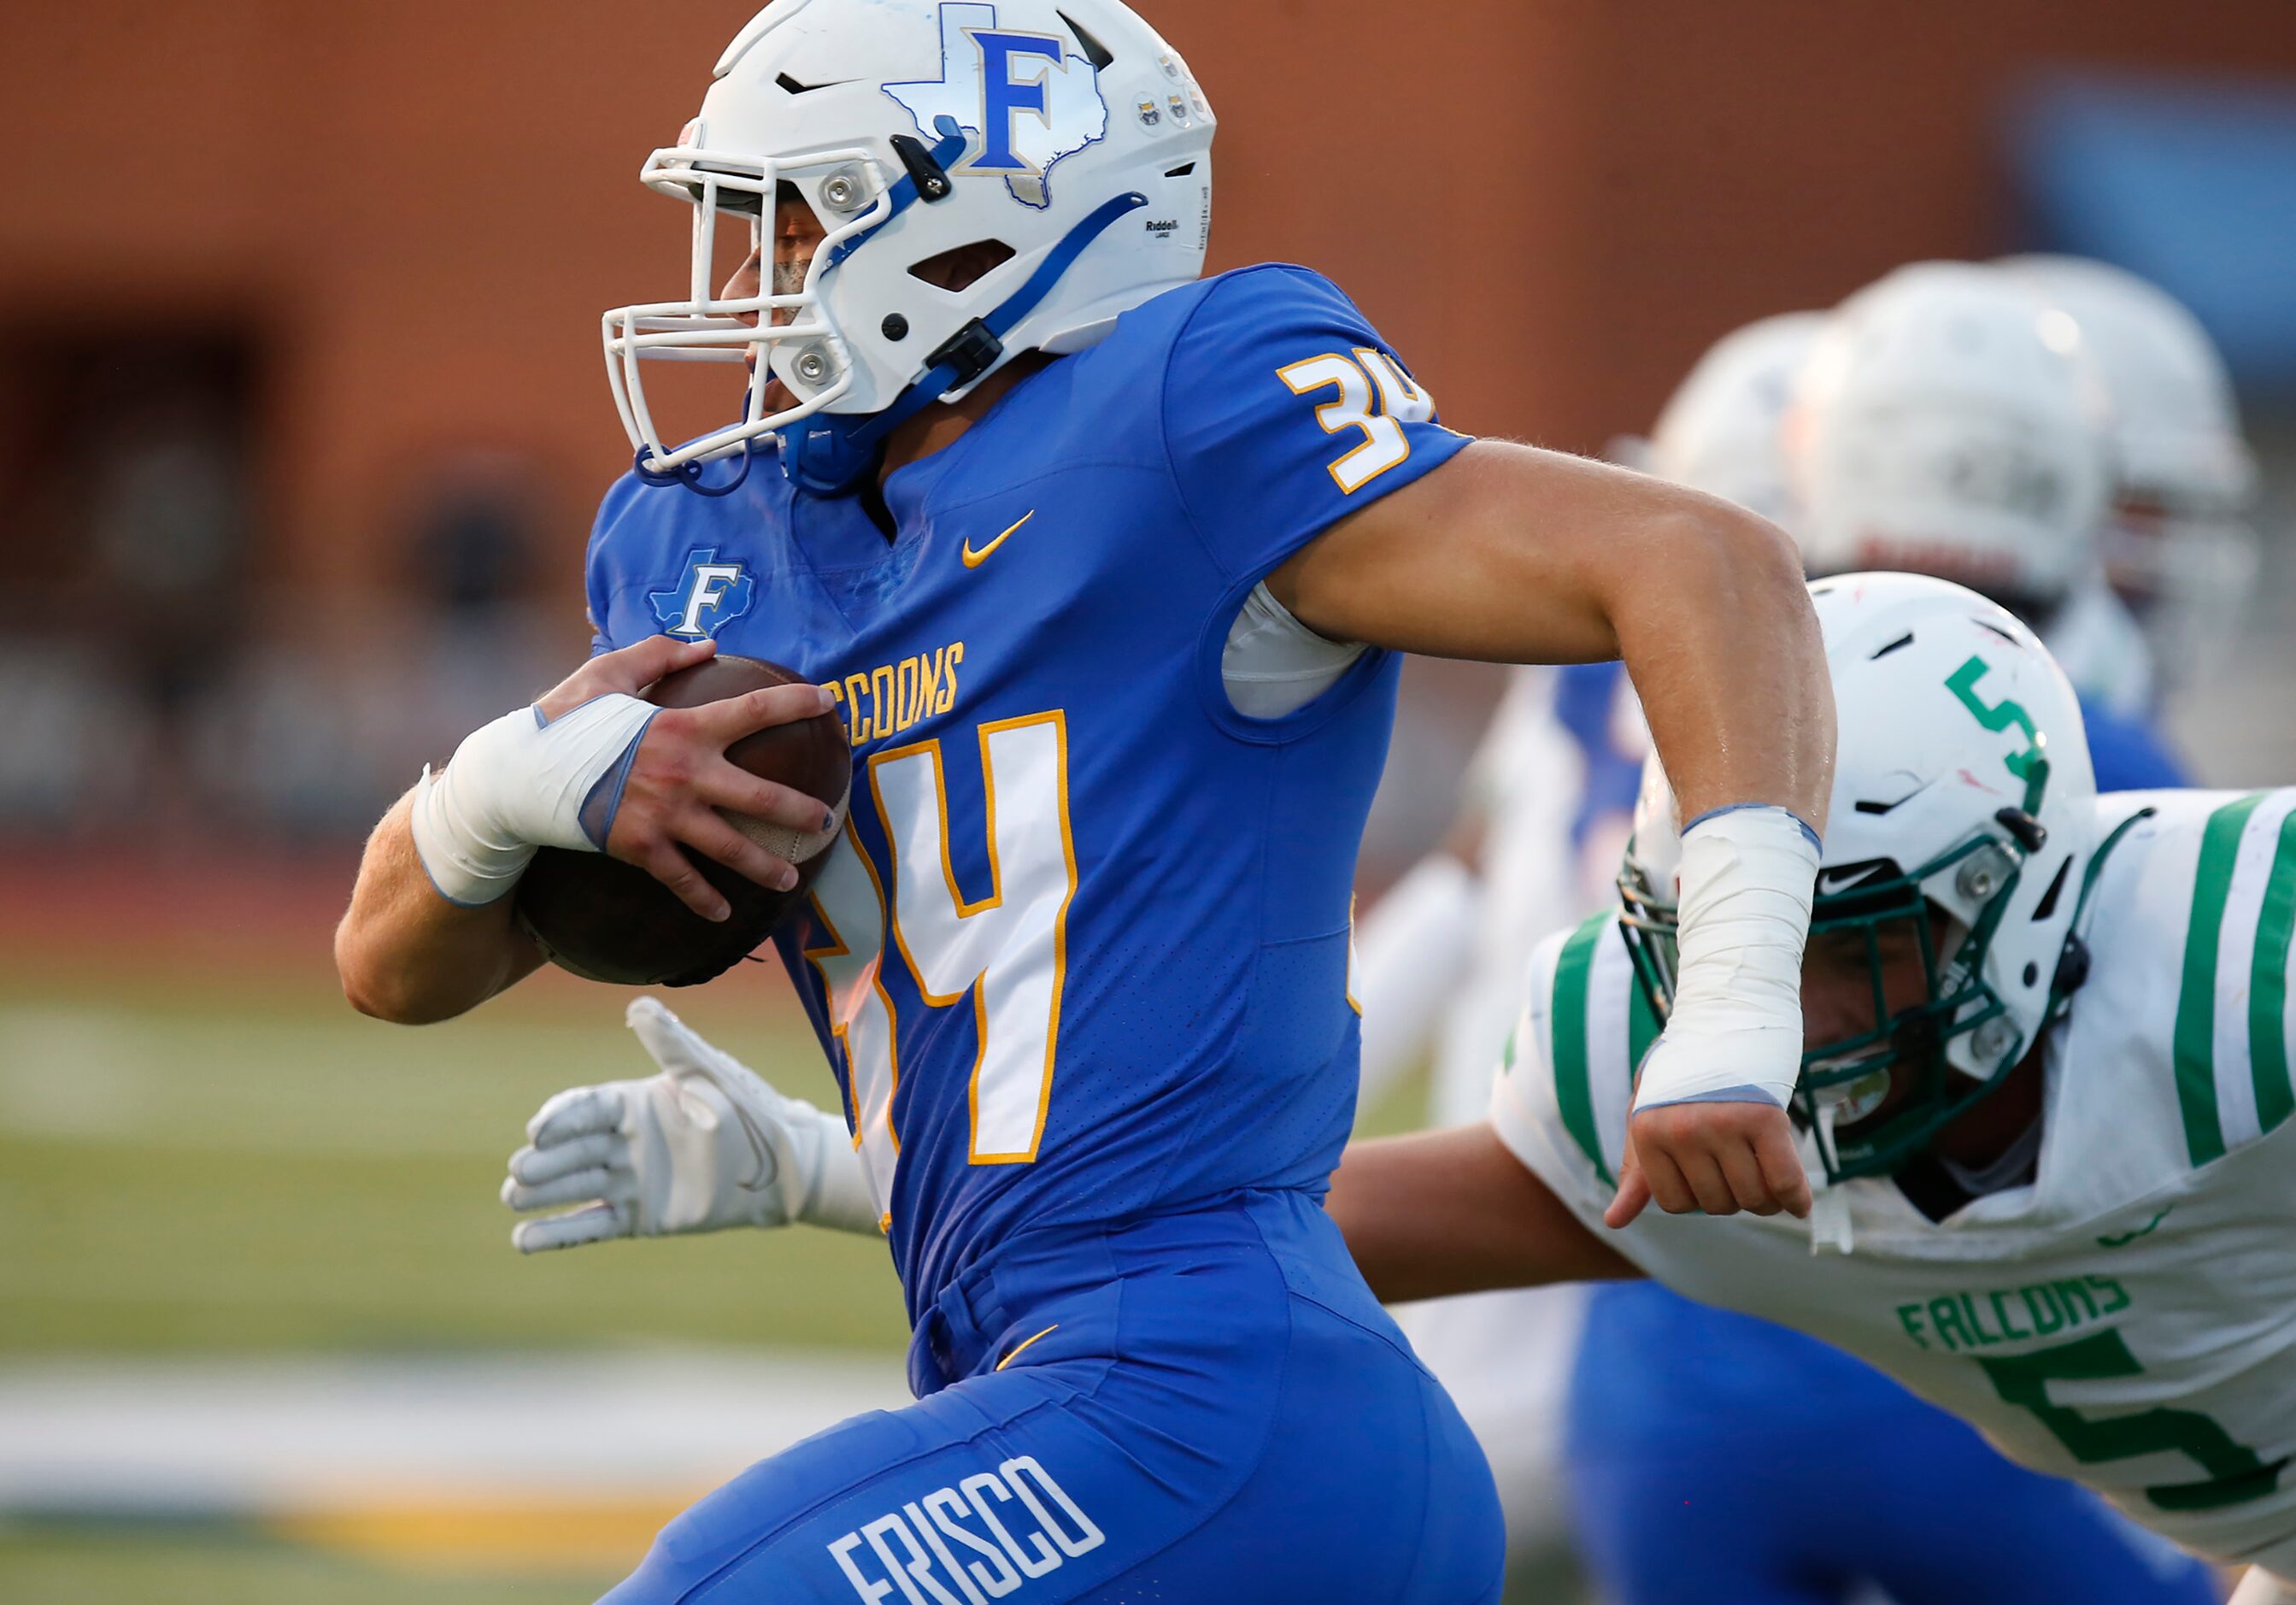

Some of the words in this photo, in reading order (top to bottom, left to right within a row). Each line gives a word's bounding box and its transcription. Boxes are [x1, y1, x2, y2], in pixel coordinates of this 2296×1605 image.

[951, 26, 1068, 176] F
[1276, 348, 1436, 496] 34
[666, 564, 742, 636] F
[1944, 655, 2046, 783] 5
[1897, 1274, 2131, 1352] FALCONS
[1970, 1327, 2281, 1511] 5
[826, 1455, 1105, 1605] FRISCO
